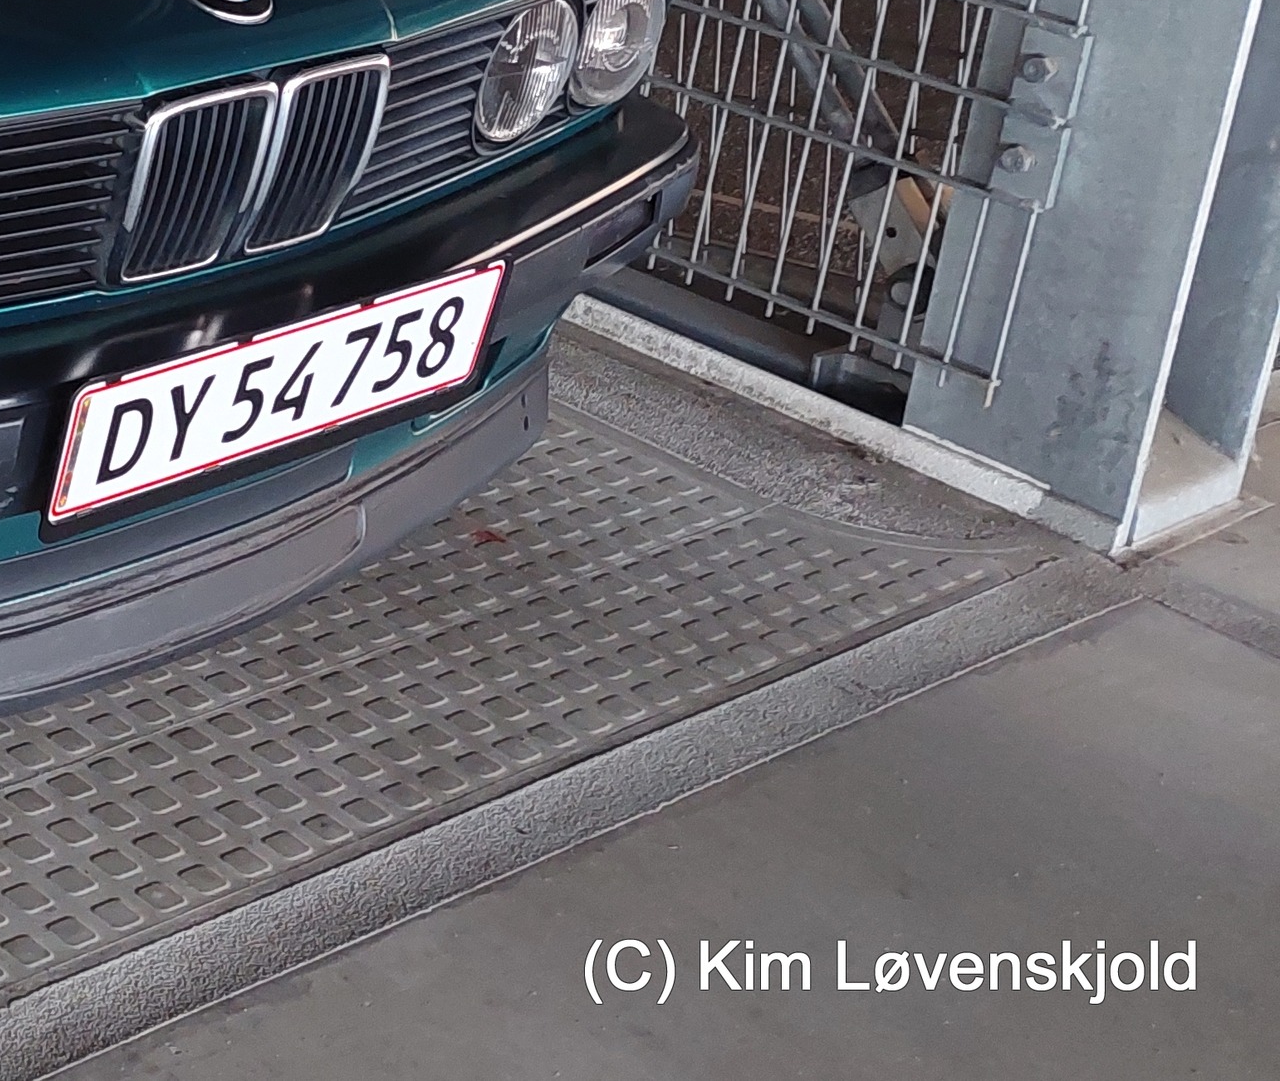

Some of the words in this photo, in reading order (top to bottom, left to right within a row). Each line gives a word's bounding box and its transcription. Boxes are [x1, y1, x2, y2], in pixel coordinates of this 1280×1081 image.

[95, 374, 217, 486] DY
[220, 340, 324, 444] 54
[330, 295, 465, 409] 758
